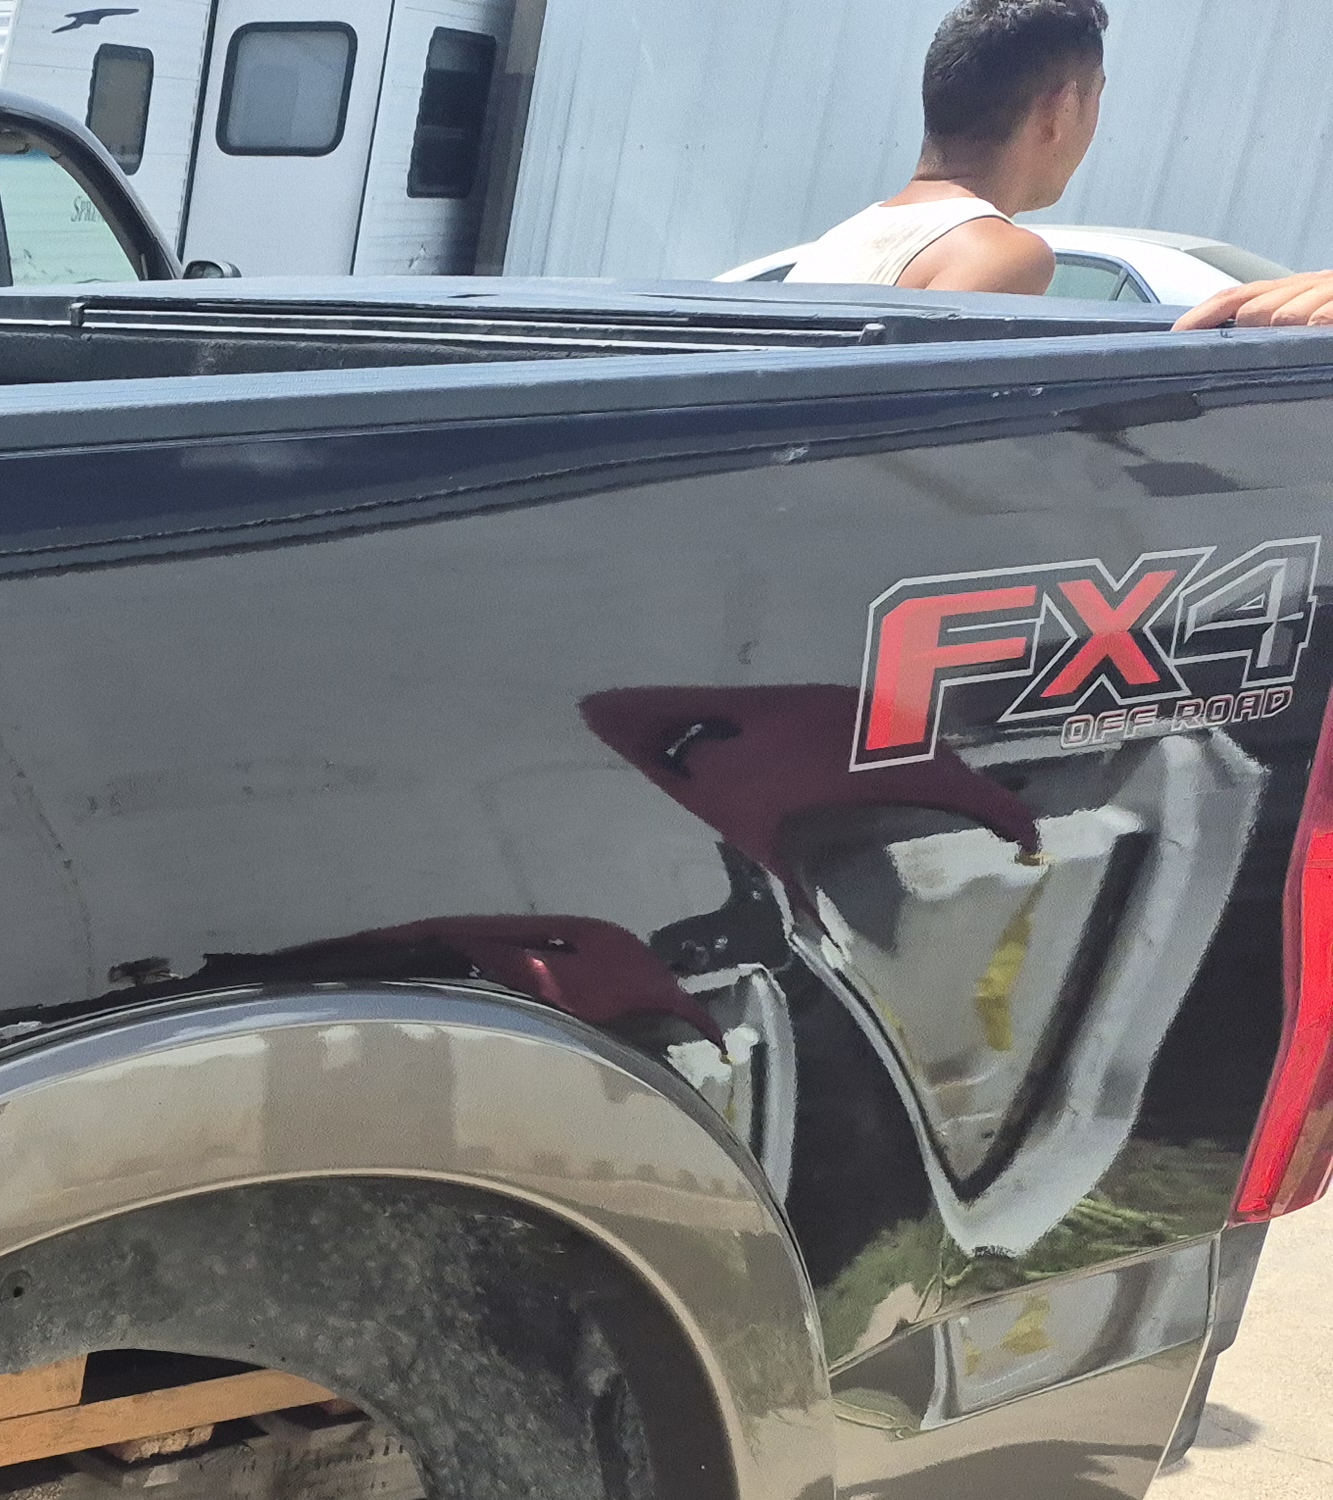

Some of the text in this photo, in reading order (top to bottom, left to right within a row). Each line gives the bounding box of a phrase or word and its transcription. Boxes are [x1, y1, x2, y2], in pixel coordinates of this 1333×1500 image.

[848, 536, 1321, 772] FX4
[1060, 685, 1293, 749] OFF ROAD
